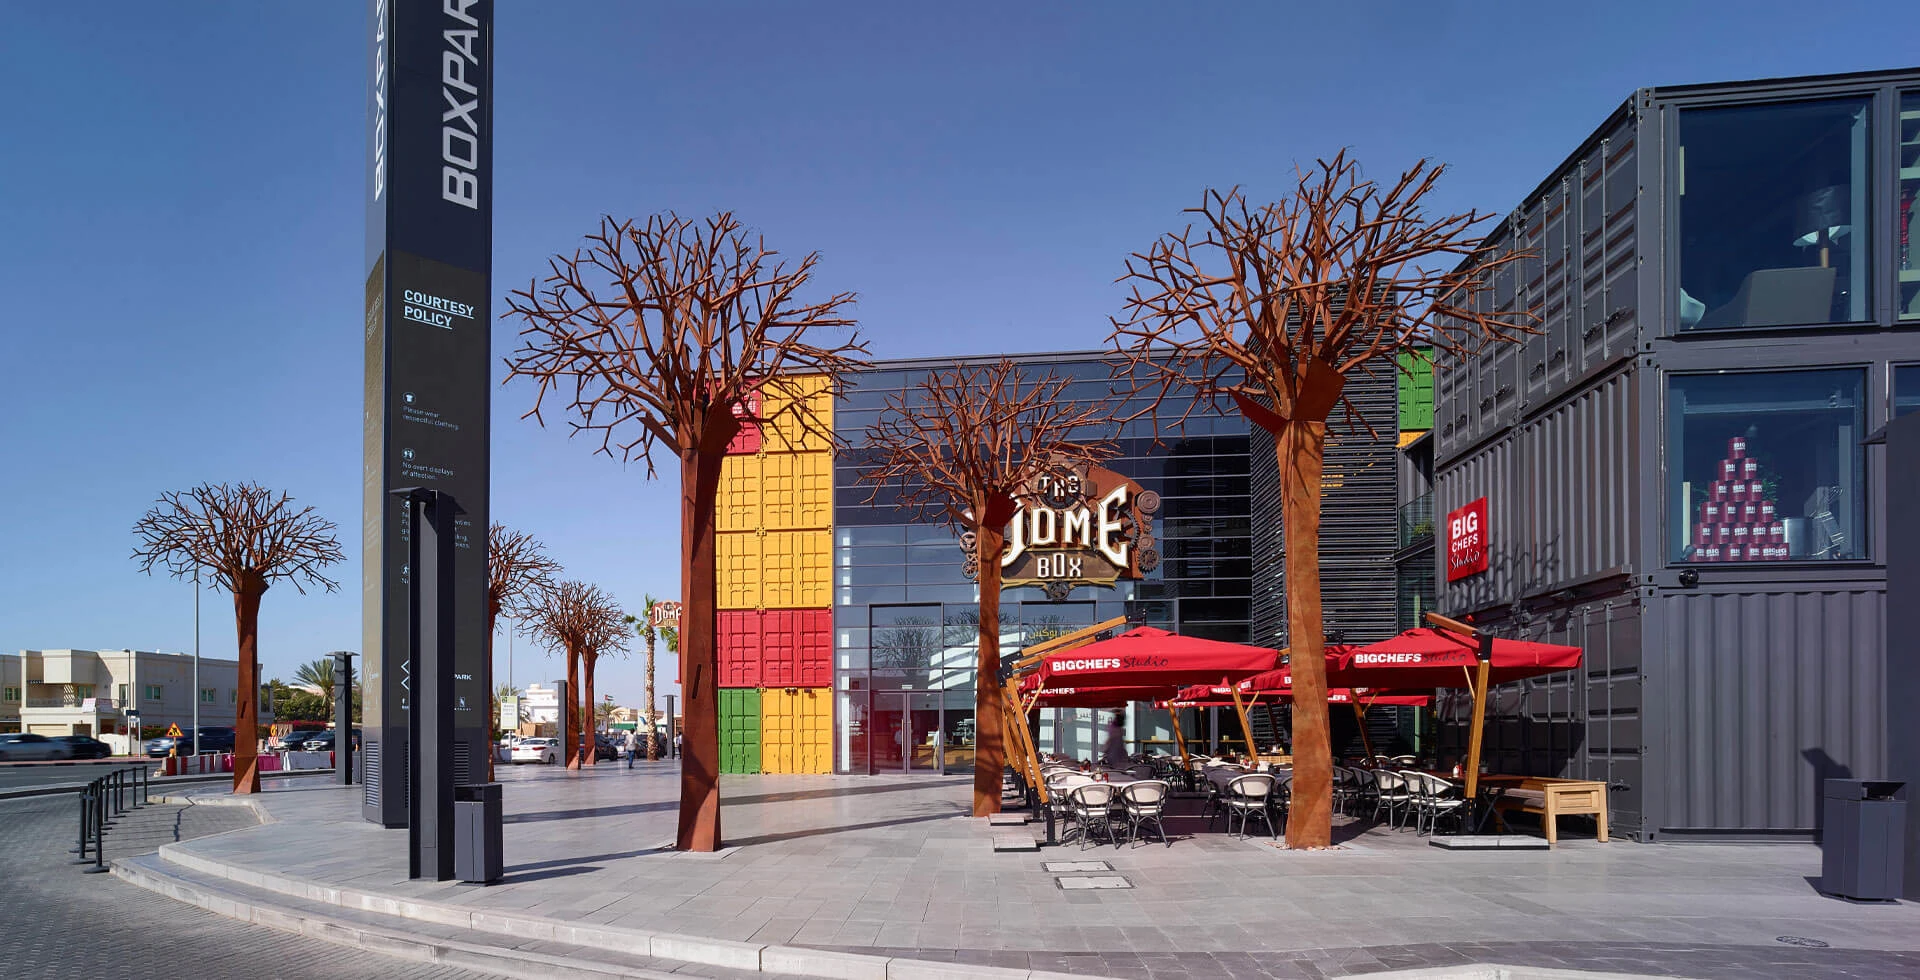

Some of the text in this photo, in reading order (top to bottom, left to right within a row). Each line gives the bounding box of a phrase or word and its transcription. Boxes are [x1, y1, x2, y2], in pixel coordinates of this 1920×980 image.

[404, 289, 474, 316] COURTESY
[404, 305, 452, 327] POLICY
[1452, 511, 1478, 540] BIG
[1451, 533, 1478, 553] CHEFS
[1037, 553, 1082, 578] BOX
[1051, 655, 1169, 671] BIGCHEFS Studio
[1355, 652, 1467, 663] BIGCHEFS Studio
